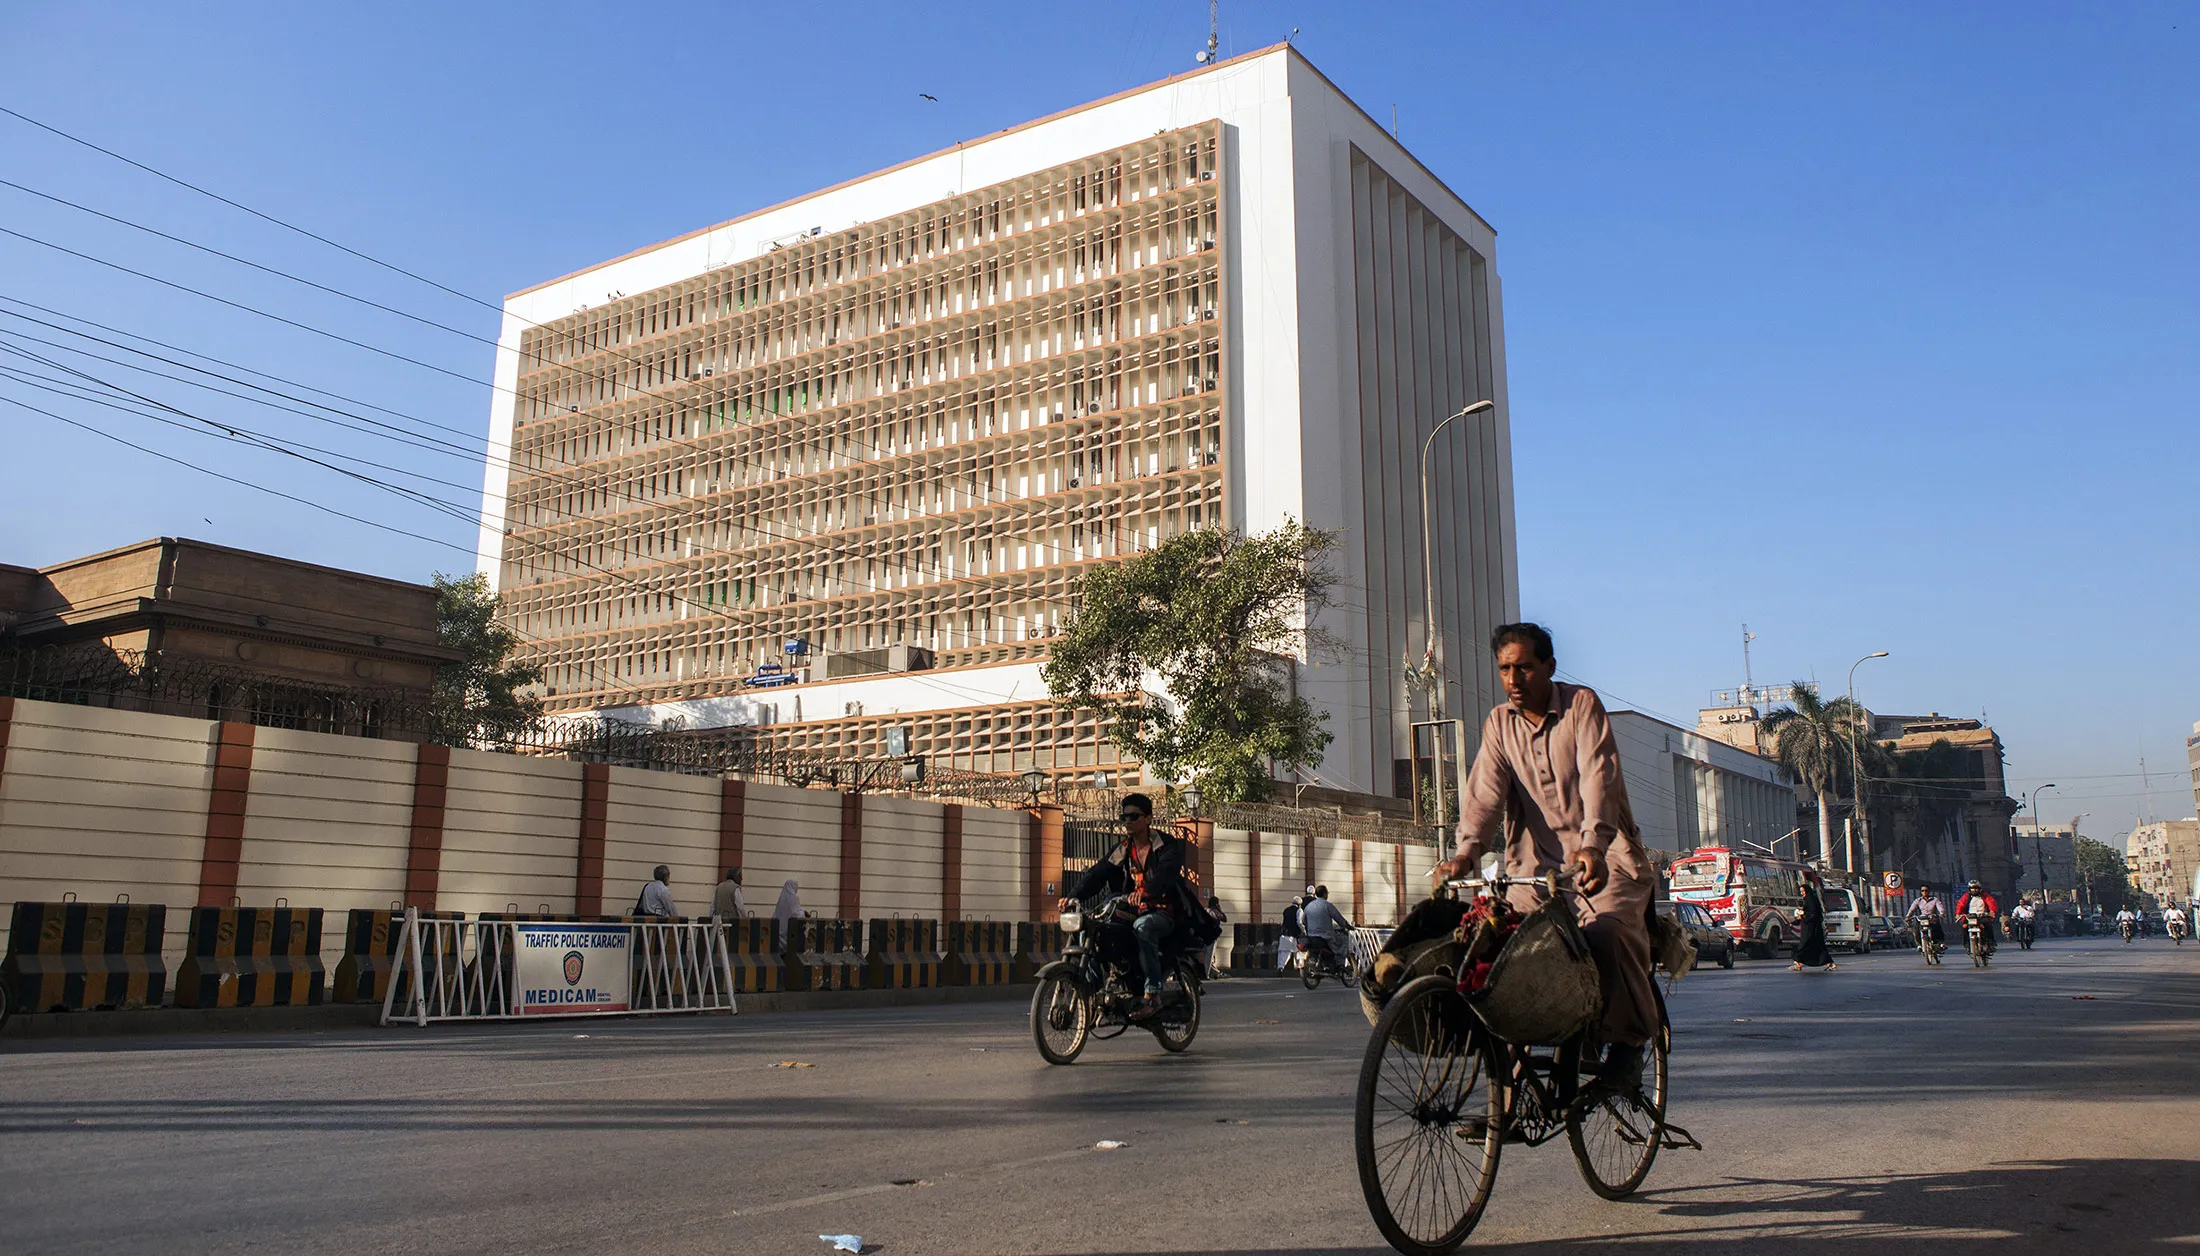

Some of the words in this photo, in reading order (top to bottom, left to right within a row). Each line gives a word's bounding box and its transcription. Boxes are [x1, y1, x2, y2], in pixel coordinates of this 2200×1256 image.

[1890, 875, 1898, 886] P
[1048, 884, 1055, 895] 4
[525, 934, 559, 948] TRAFFIC
[560, 934, 589, 948] POLICE
[590, 934, 626, 949] KARACHI
[525, 988, 597, 1004] MEDICAM
